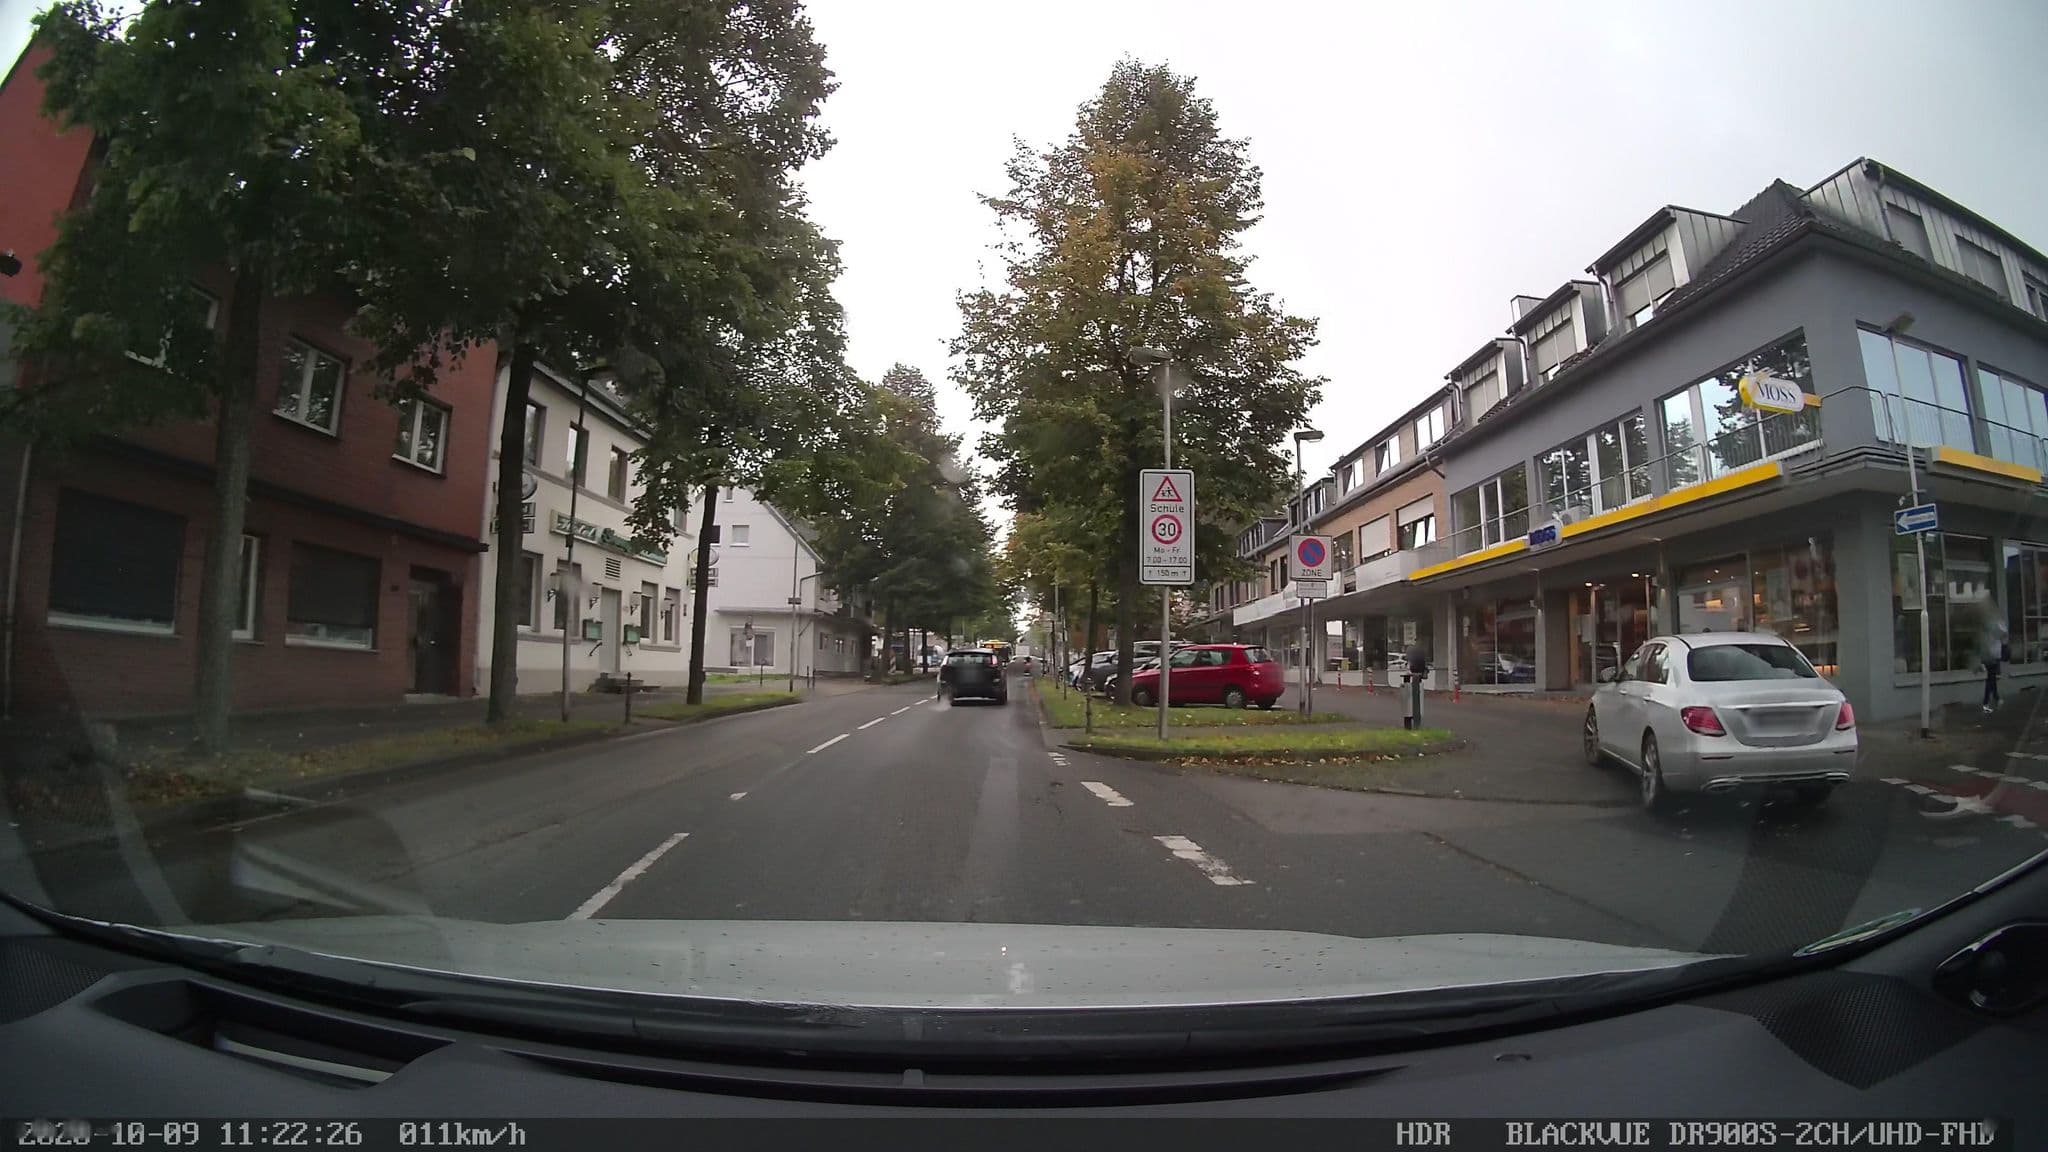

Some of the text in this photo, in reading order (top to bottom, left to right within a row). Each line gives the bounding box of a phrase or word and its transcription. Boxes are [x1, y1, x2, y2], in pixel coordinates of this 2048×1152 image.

[1756, 381, 1796, 402] MOSS
[1150, 504, 1184, 512] Schule
[1158, 523, 1176, 536] 30
[1301, 568, 1322, 576] ZONE
